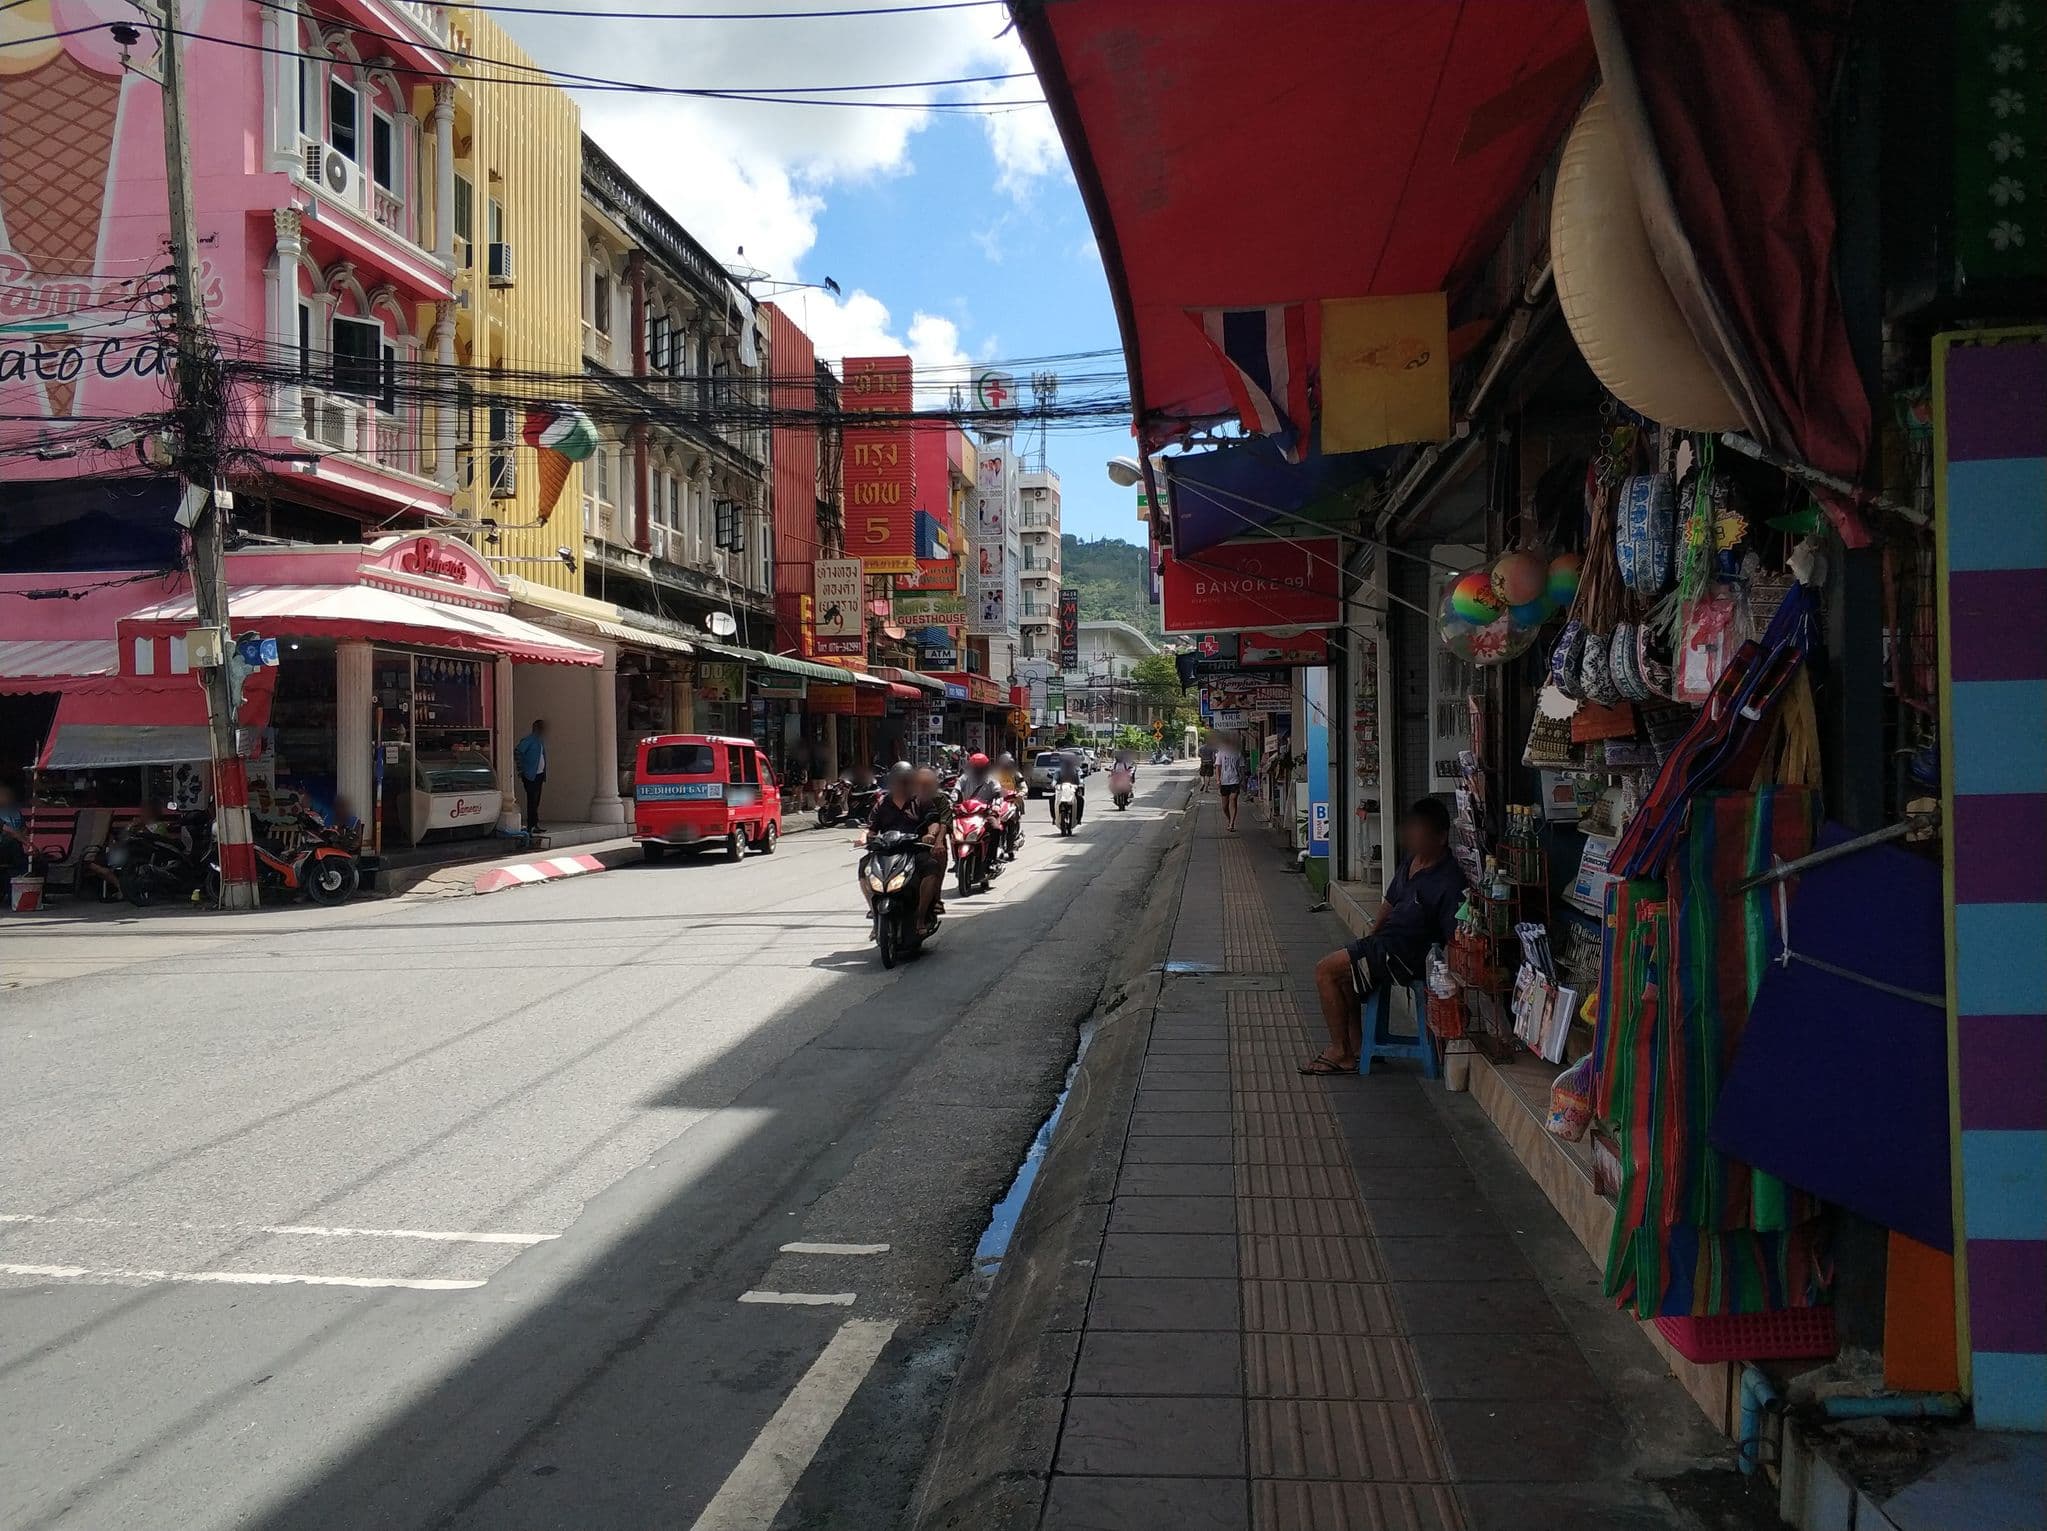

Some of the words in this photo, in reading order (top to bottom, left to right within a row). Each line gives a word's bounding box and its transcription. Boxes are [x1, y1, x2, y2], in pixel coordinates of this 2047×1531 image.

[865, 517, 891, 544] 5
[1195, 576, 1280, 595] BAIYOKE
[897, 613, 967, 625] GUESTHOUSE
[931, 649, 951, 658] ATM
